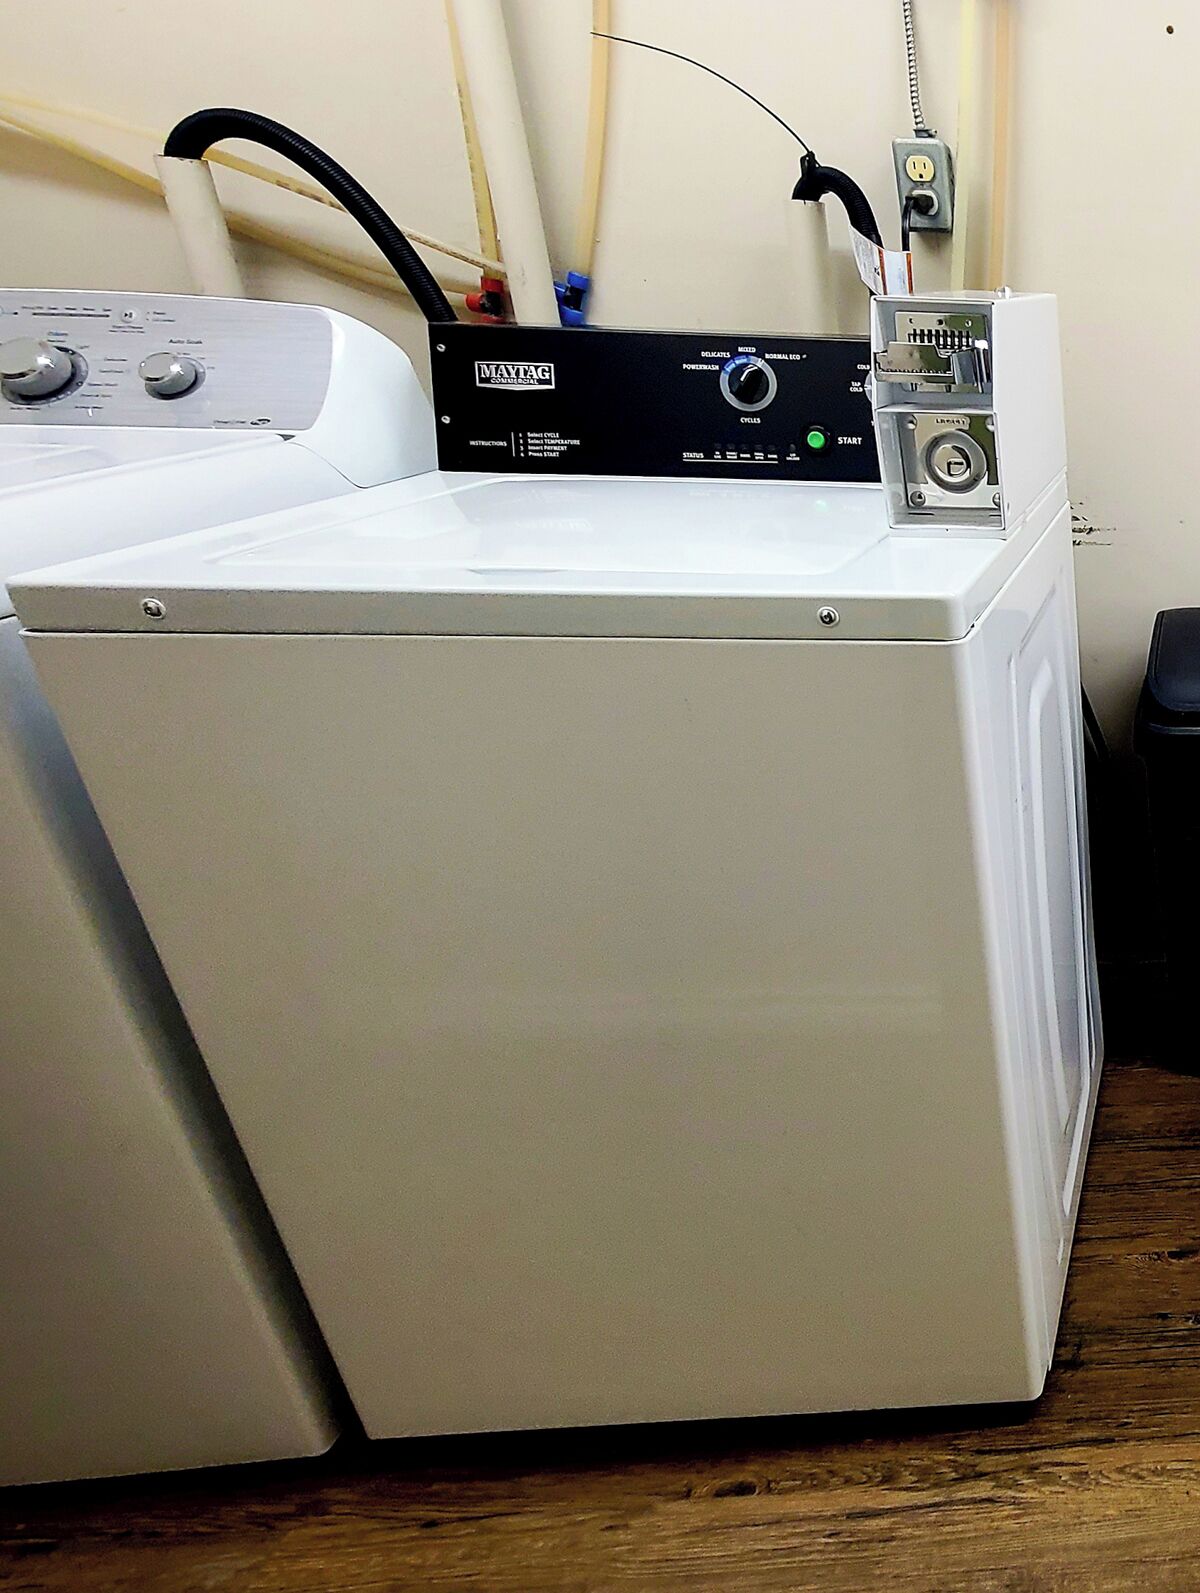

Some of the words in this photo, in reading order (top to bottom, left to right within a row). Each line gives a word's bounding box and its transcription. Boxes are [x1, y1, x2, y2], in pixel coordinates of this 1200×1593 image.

[479, 364, 551, 380] MAYTAG
[490, 377, 539, 385] COMMERCIAL
[837, 436, 862, 445] START
